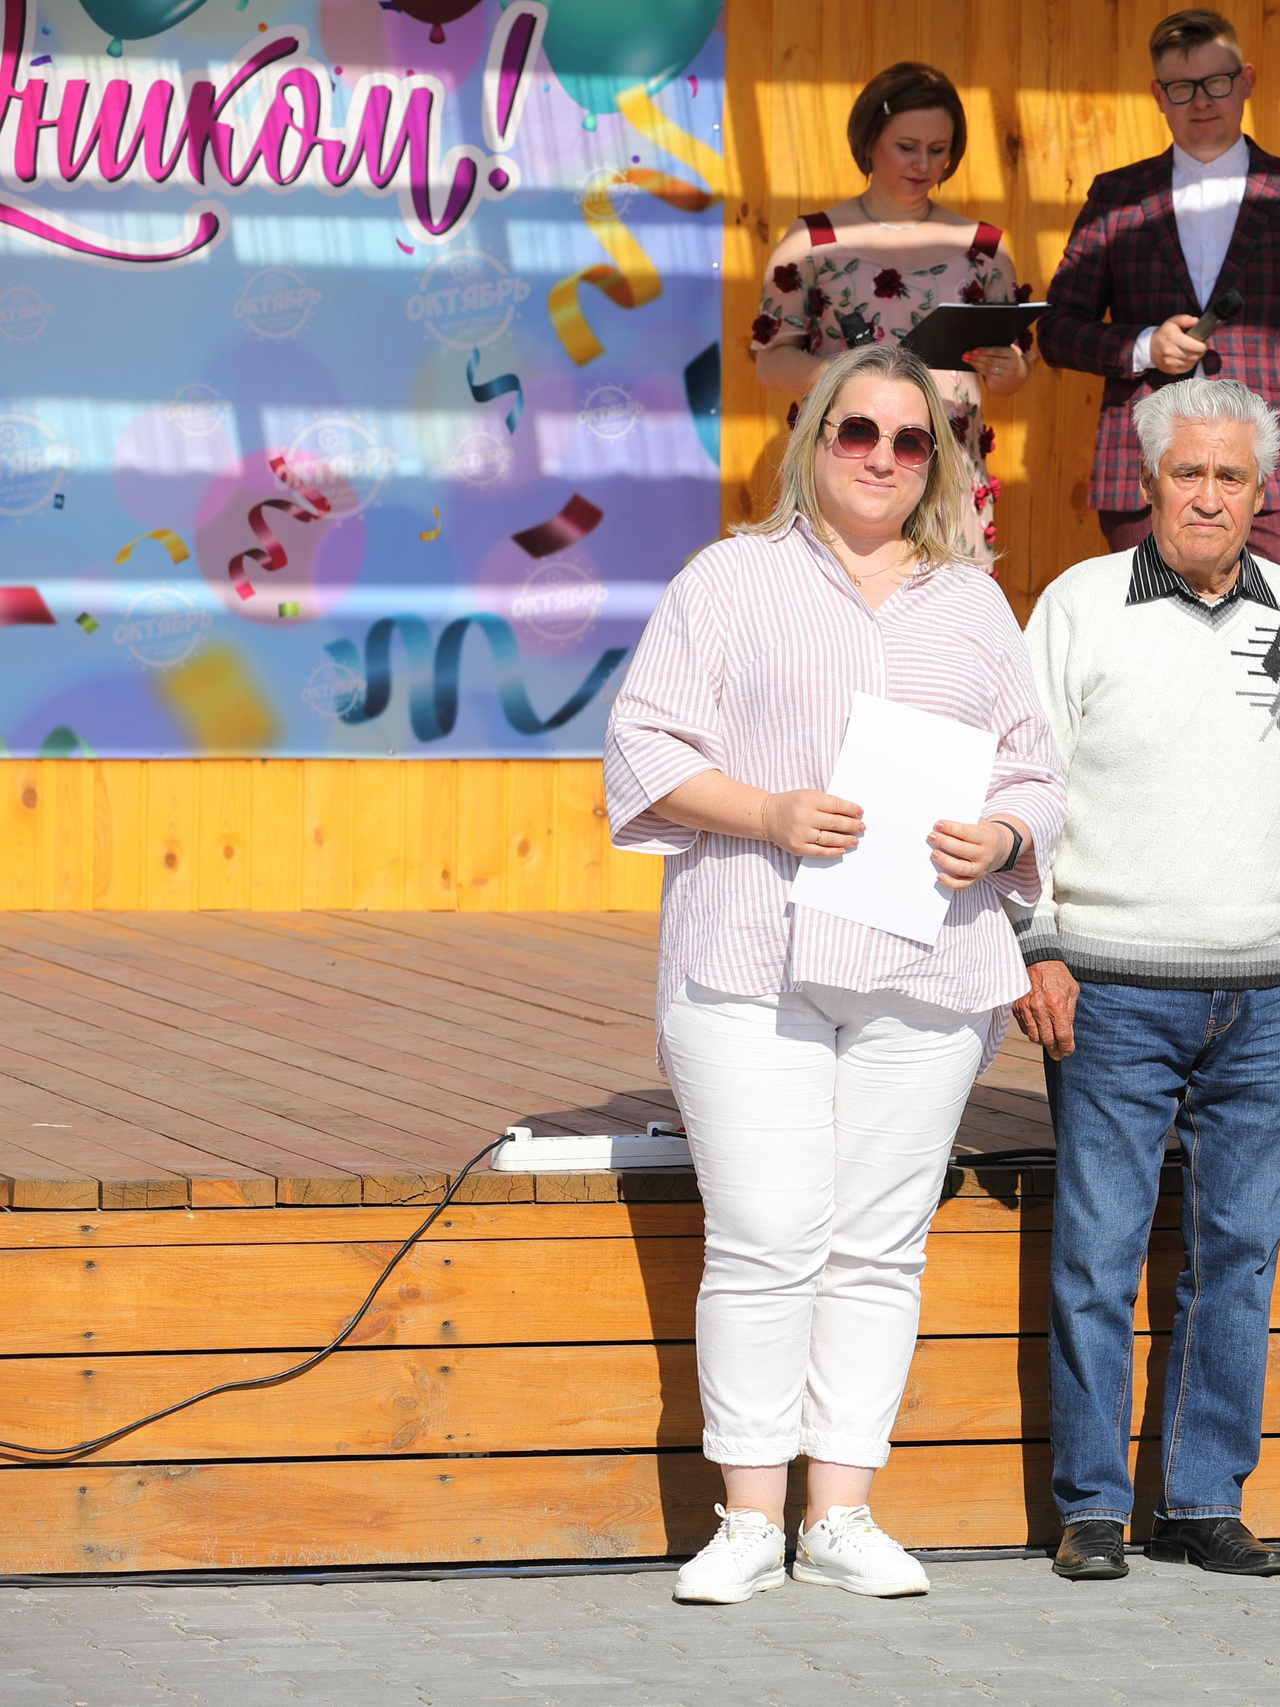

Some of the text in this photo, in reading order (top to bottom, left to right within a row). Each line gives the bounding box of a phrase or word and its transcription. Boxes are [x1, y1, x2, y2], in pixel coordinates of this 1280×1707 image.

[232, 287, 322, 319] ОКТЯБРЬ
[406, 277, 531, 321] ОКТЯБРЬ
[511, 583, 610, 618] ОКТЯБРЬ
[113, 608, 214, 645] ОКТЯБРЬ
